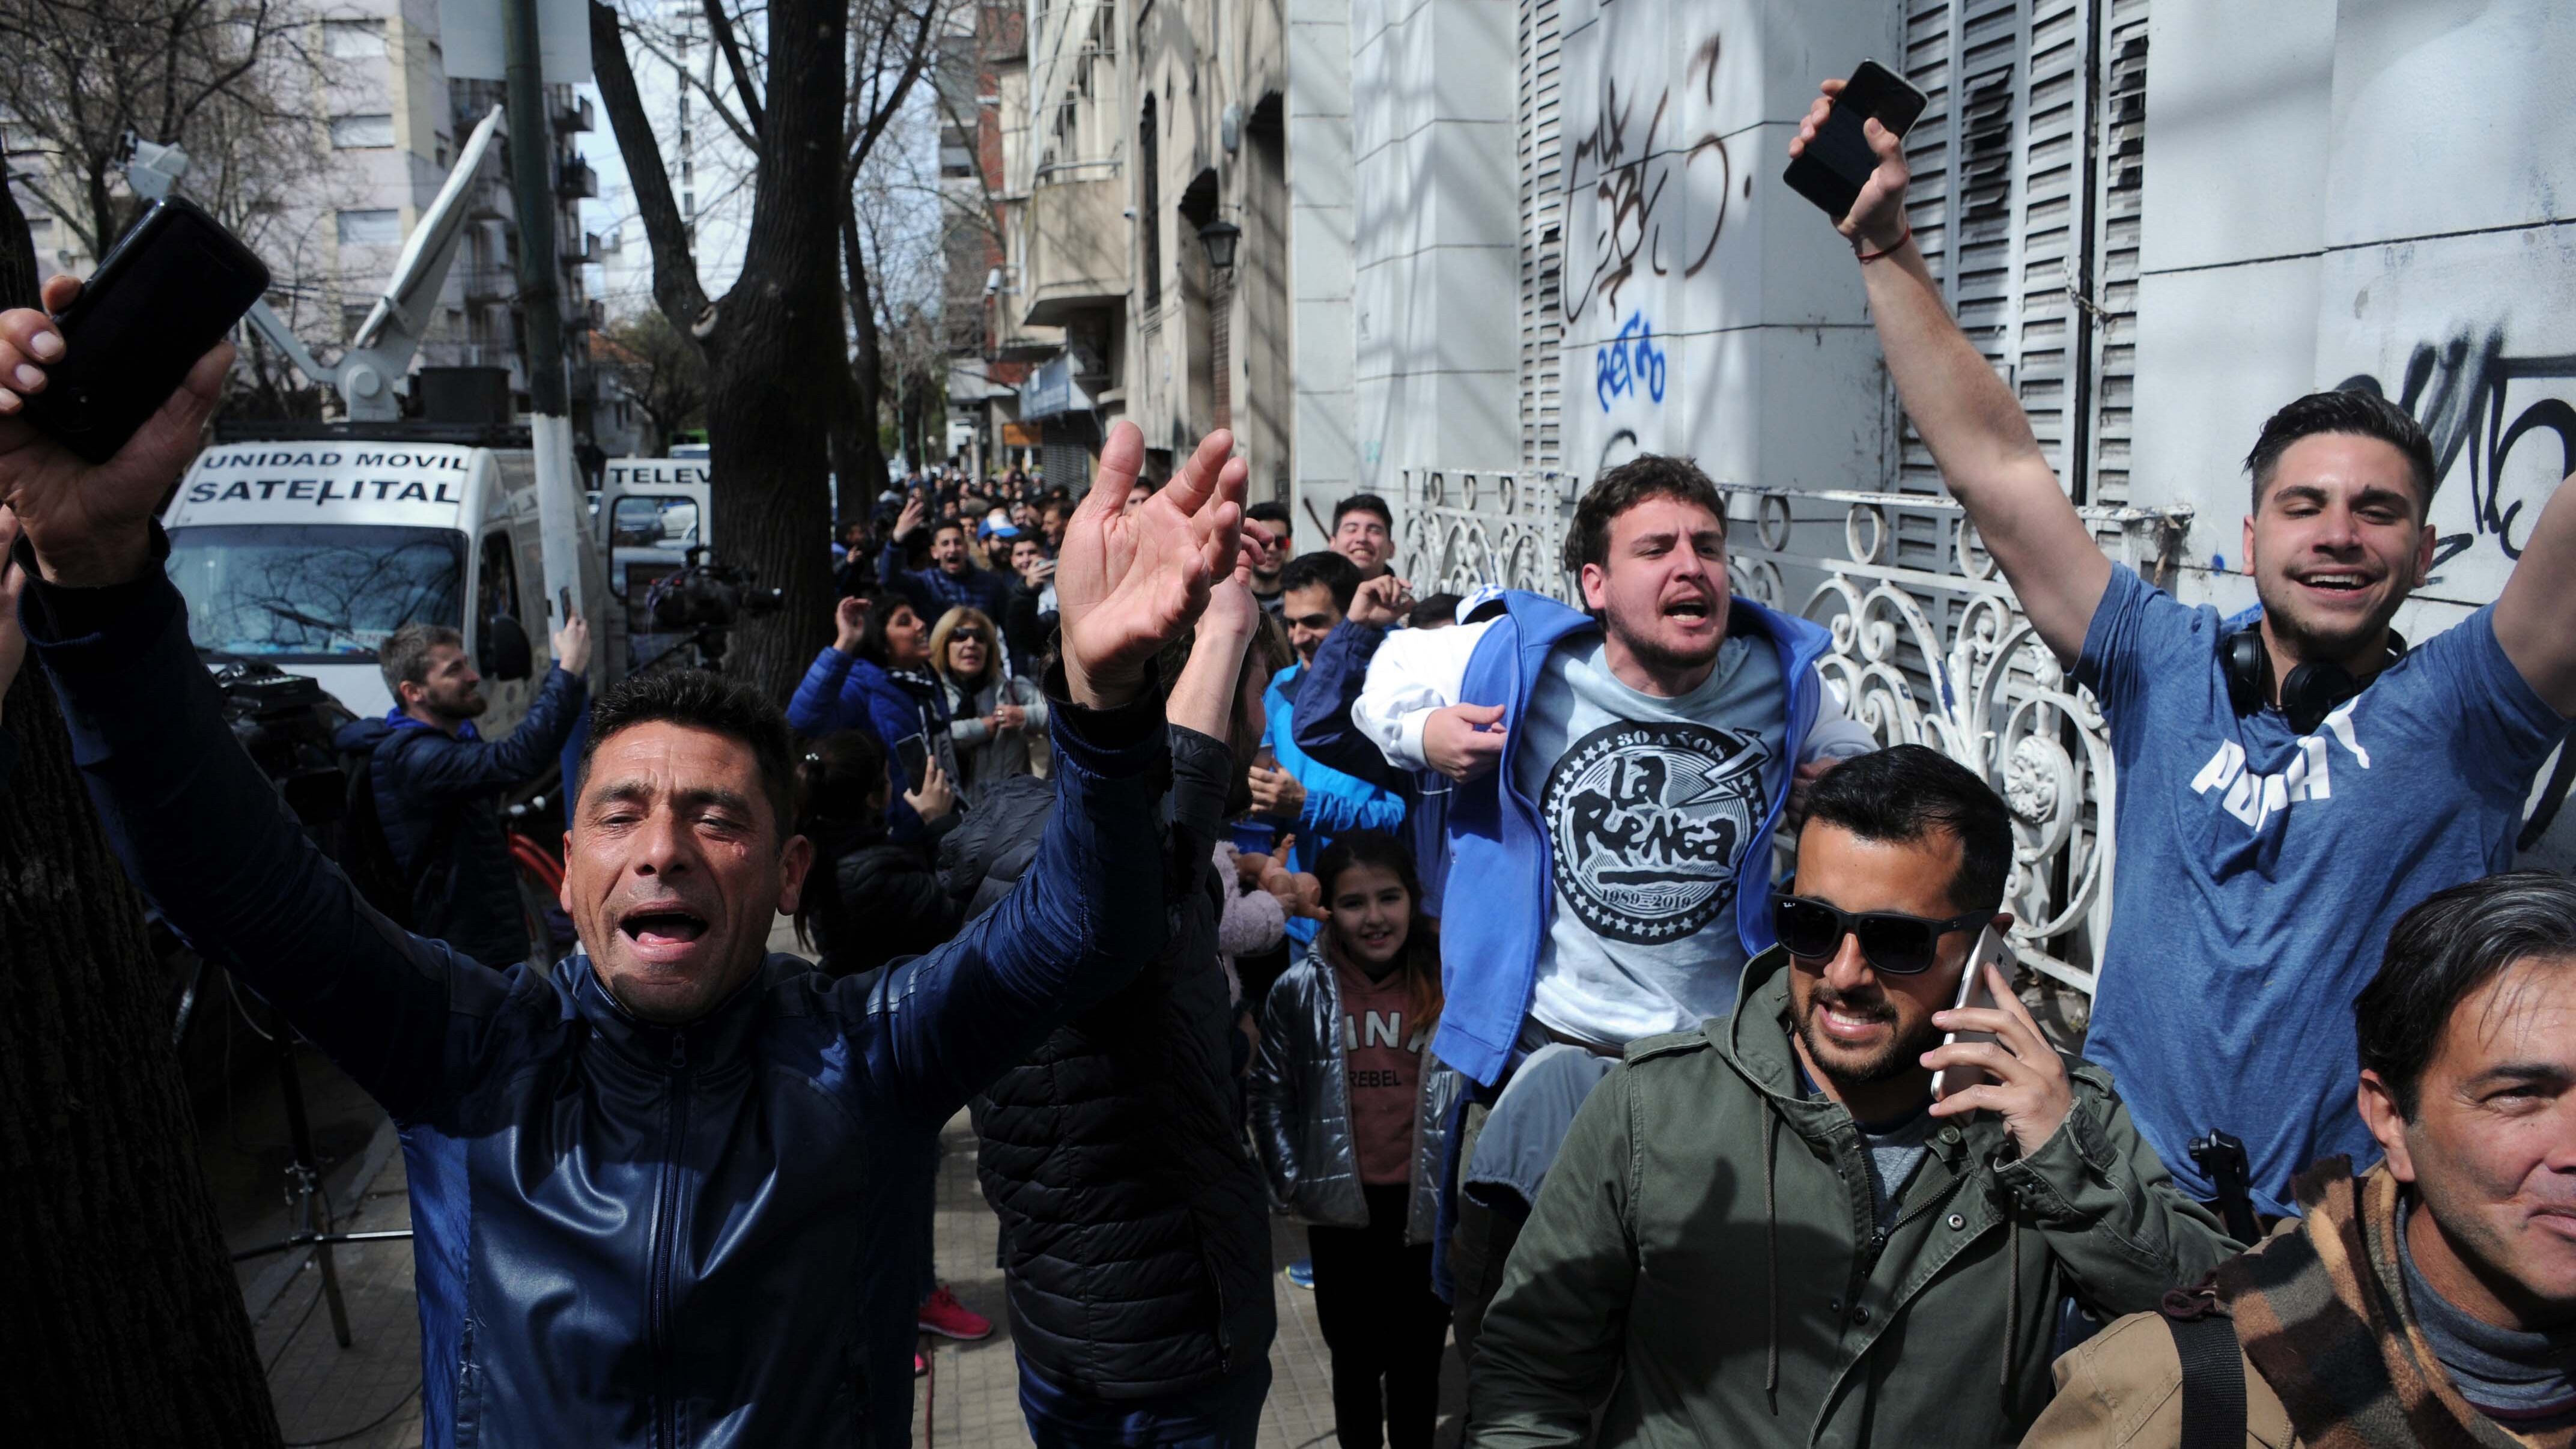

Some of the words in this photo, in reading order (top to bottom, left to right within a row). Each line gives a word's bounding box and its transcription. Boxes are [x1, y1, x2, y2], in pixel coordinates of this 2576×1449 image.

[204, 452, 342, 469] UNIDAD
[356, 454, 469, 471] MOVIL
[188, 480, 460, 503] SATELITAL
[1617, 730, 1650, 746] 30
[1656, 731, 1727, 760] AÑOS
[2190, 736, 2330, 833] PUMA
[1349, 1070, 1402, 1087] REBEL
